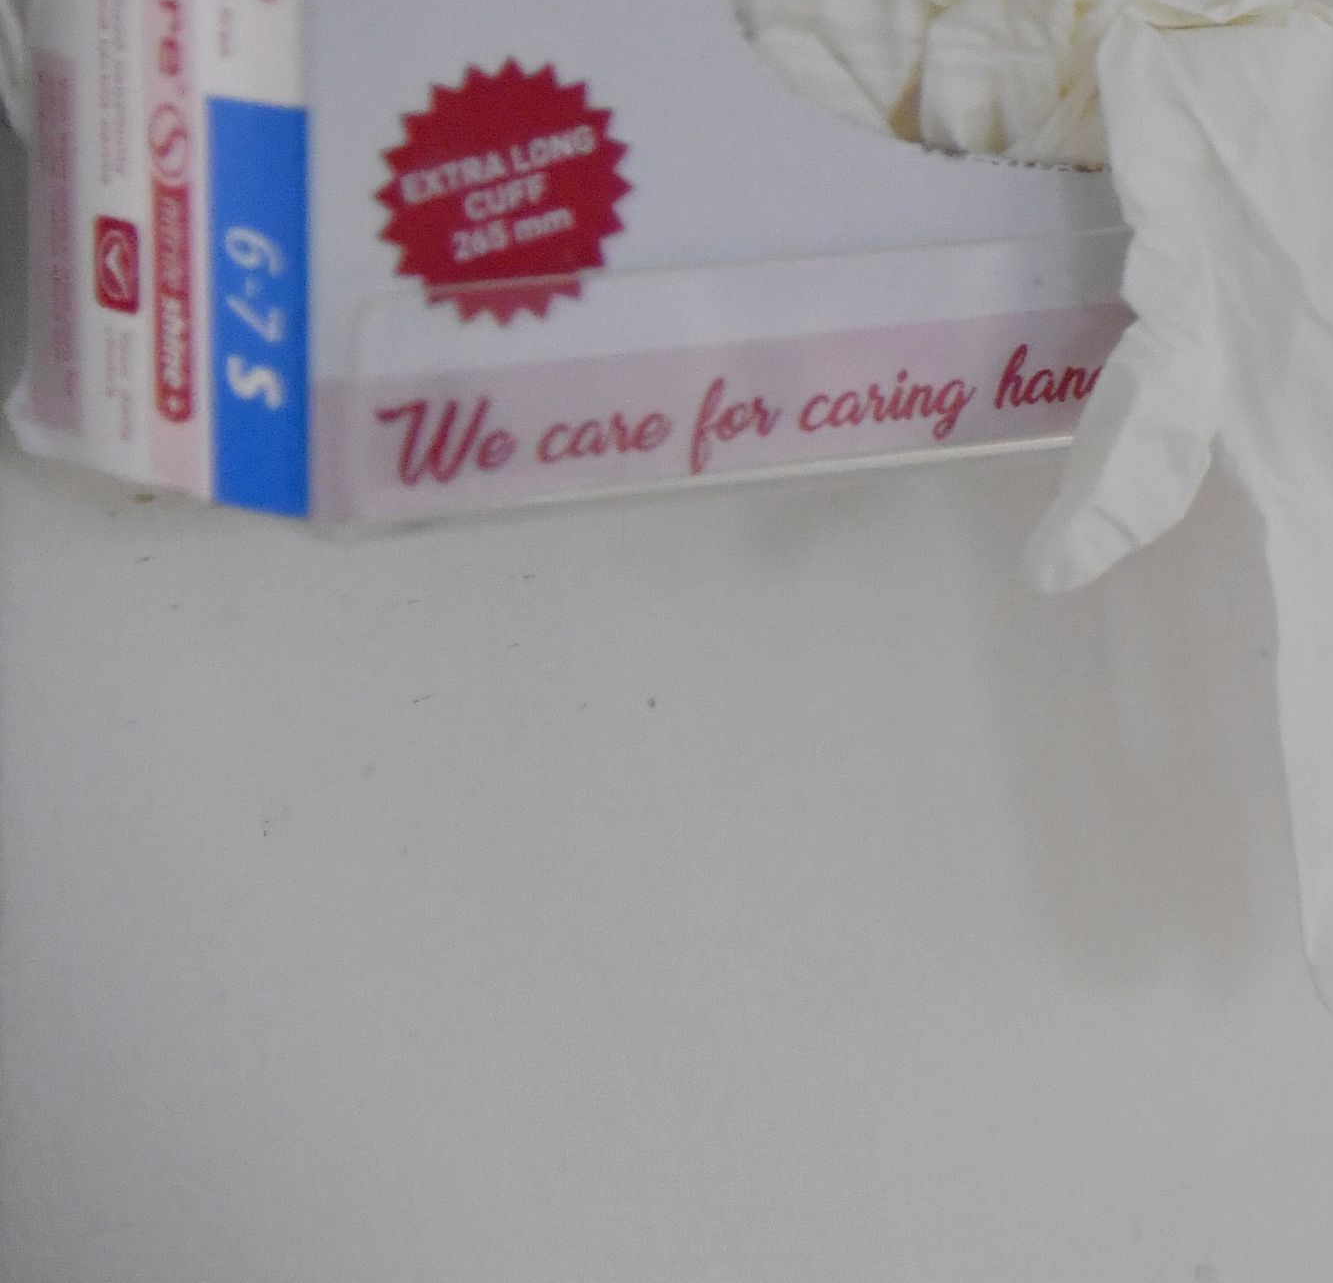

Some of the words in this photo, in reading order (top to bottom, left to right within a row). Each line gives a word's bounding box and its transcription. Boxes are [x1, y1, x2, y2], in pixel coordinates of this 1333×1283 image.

[401, 152, 510, 205] EXTRA
[508, 125, 597, 173] LONG
[463, 175, 548, 223] CUFF
[513, 205, 576, 242] mm
[224, 225, 286, 343] 6-7
[226, 354, 284, 410] S
[374, 393, 518, 487] We
[537, 409, 672, 465] care
[687, 376, 781, 476] for
[799, 369, 980, 443] caring
